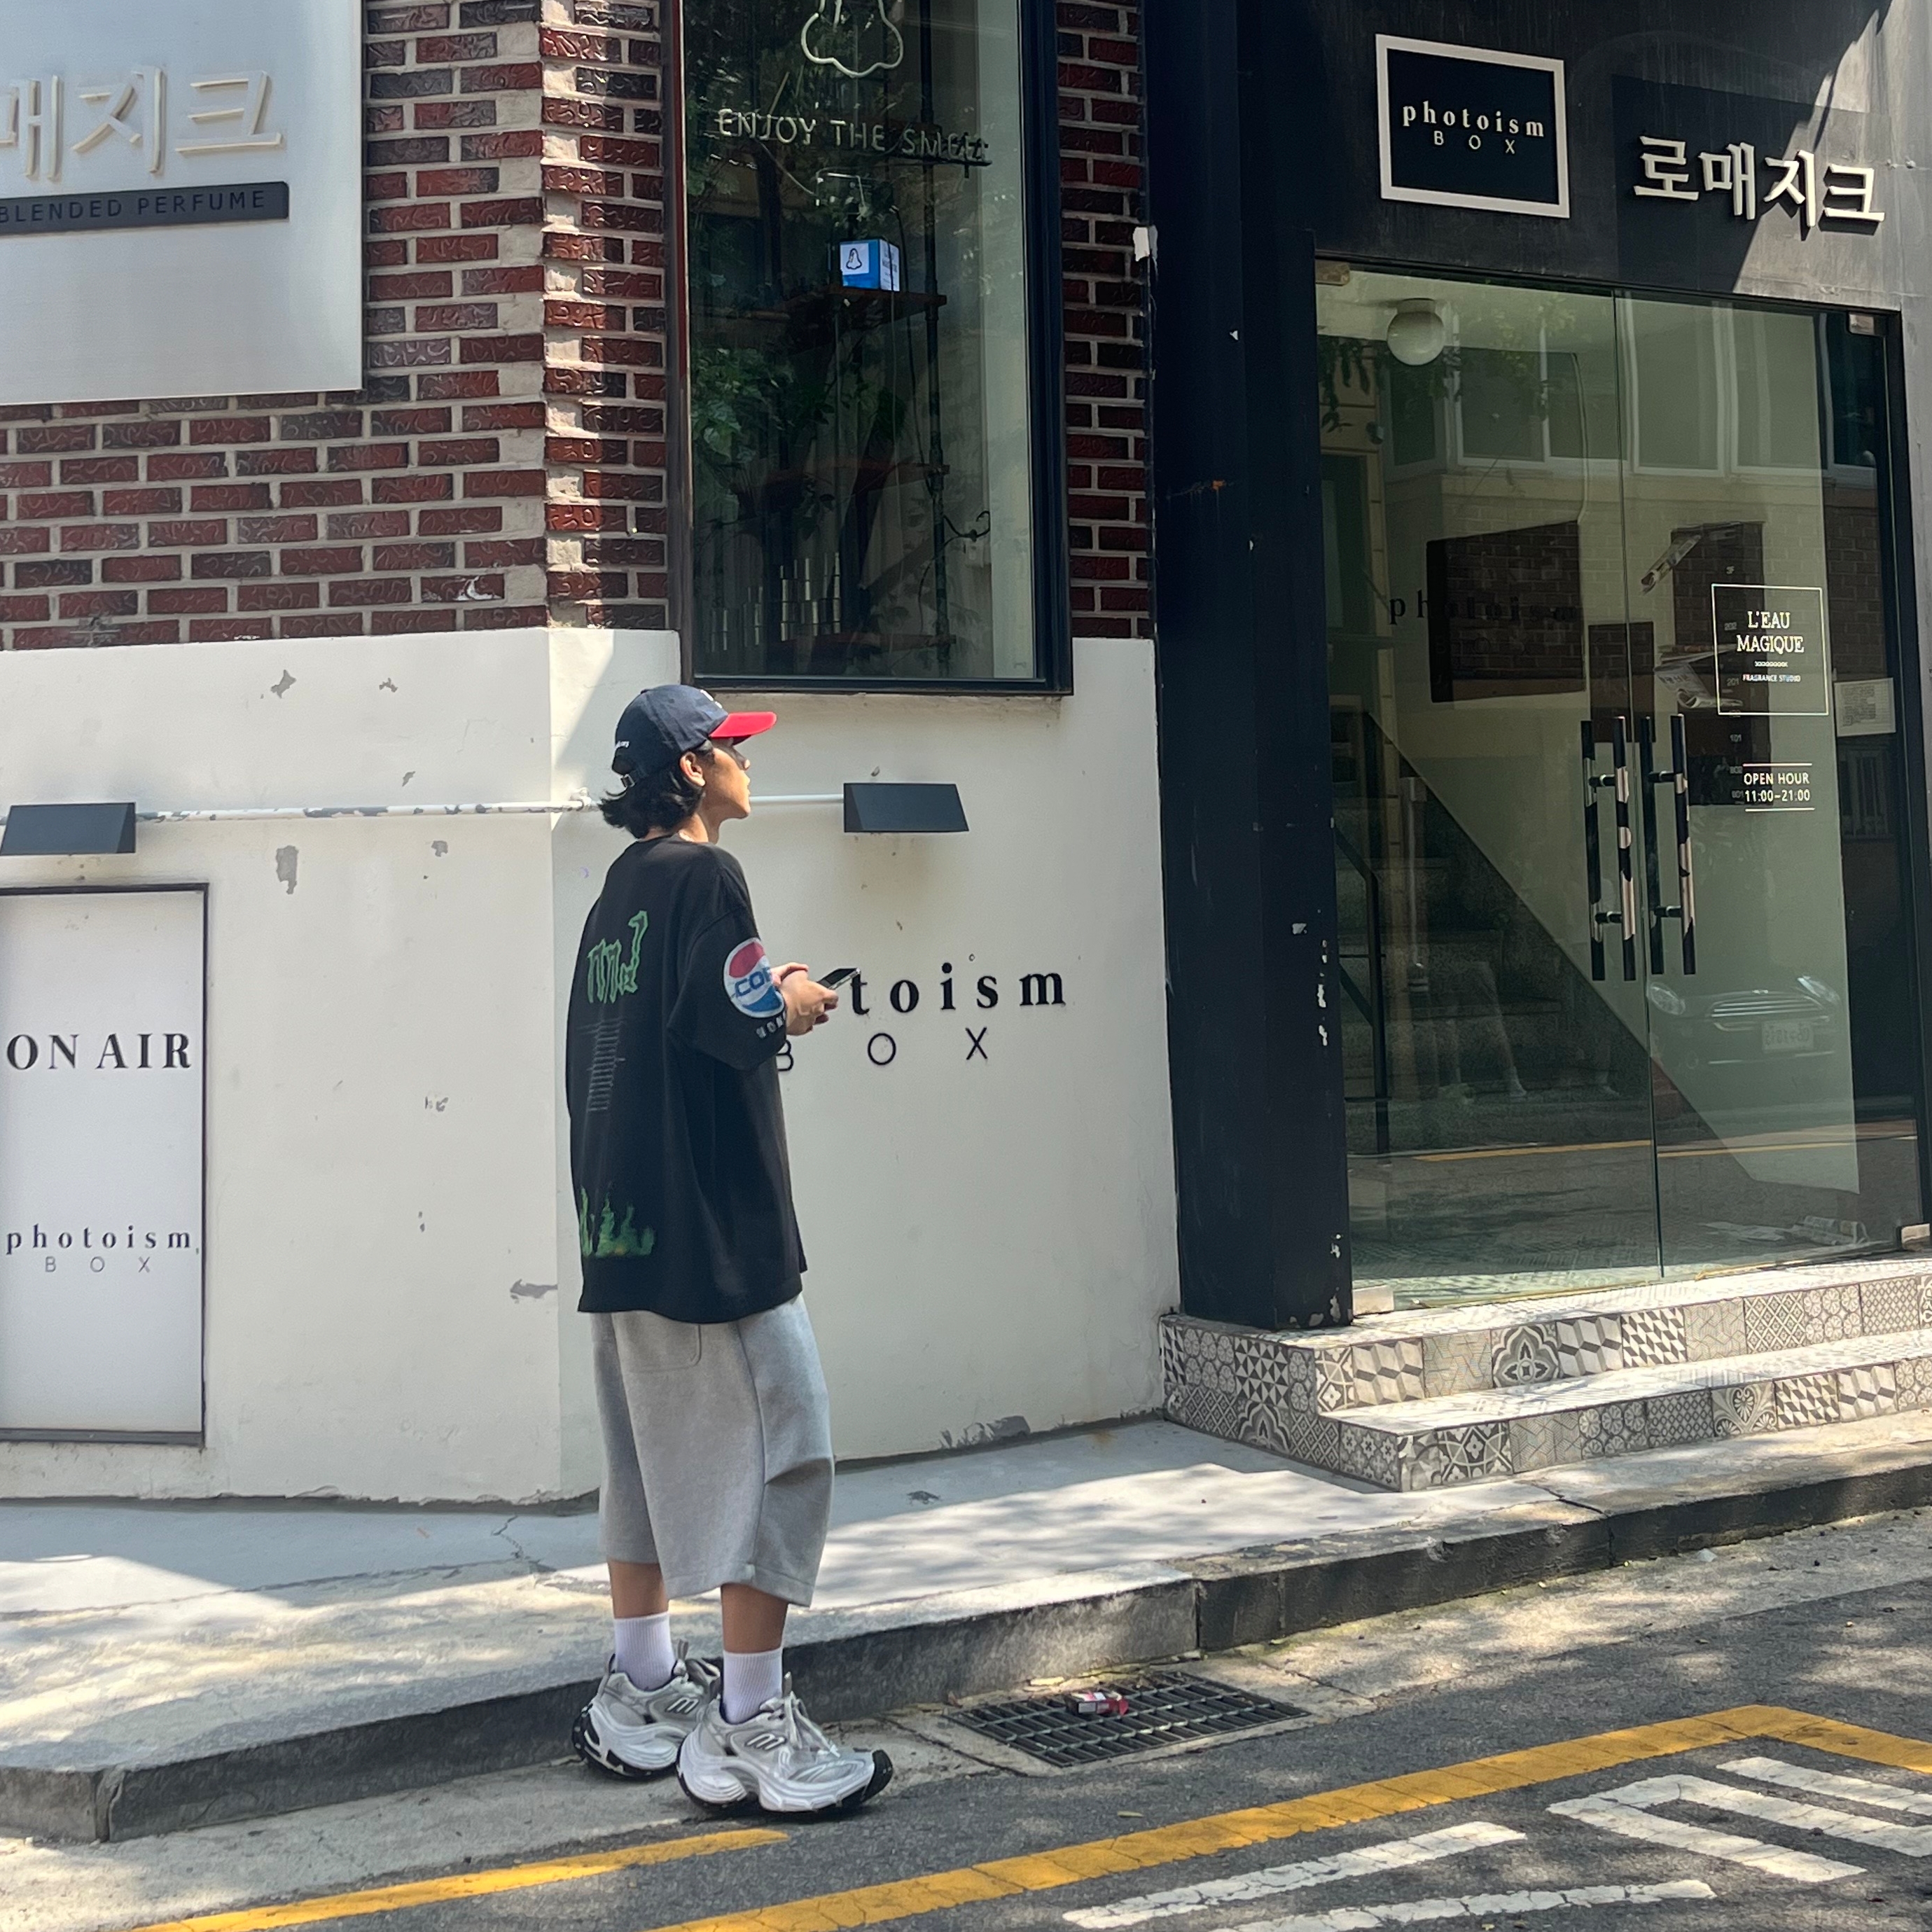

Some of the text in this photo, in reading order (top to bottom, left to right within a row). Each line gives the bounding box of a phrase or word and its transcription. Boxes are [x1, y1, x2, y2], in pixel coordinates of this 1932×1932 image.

[715, 109, 816, 145] ENJOY
[830, 120, 885, 151] THE
[1403, 100, 1544, 137] photoism
[1433, 130, 1515, 155] BOX
[1633, 136, 1886, 228] 로매지크
[0, 190, 265, 224] BLENDED PERFUME
[1747, 611, 1791, 629] L'EAU
[1737, 634, 1805, 654] MAGIQUE
[1742, 674, 1777, 683] FRAGRANCE
[1744, 772, 1810, 785] OPEN HOUR
[850, 961, 1066, 1015] toism
[6, 1033, 192, 1070] ON AIR
[6, 1223, 192, 1255] photoism
[44, 1256, 151, 1274] BOX
